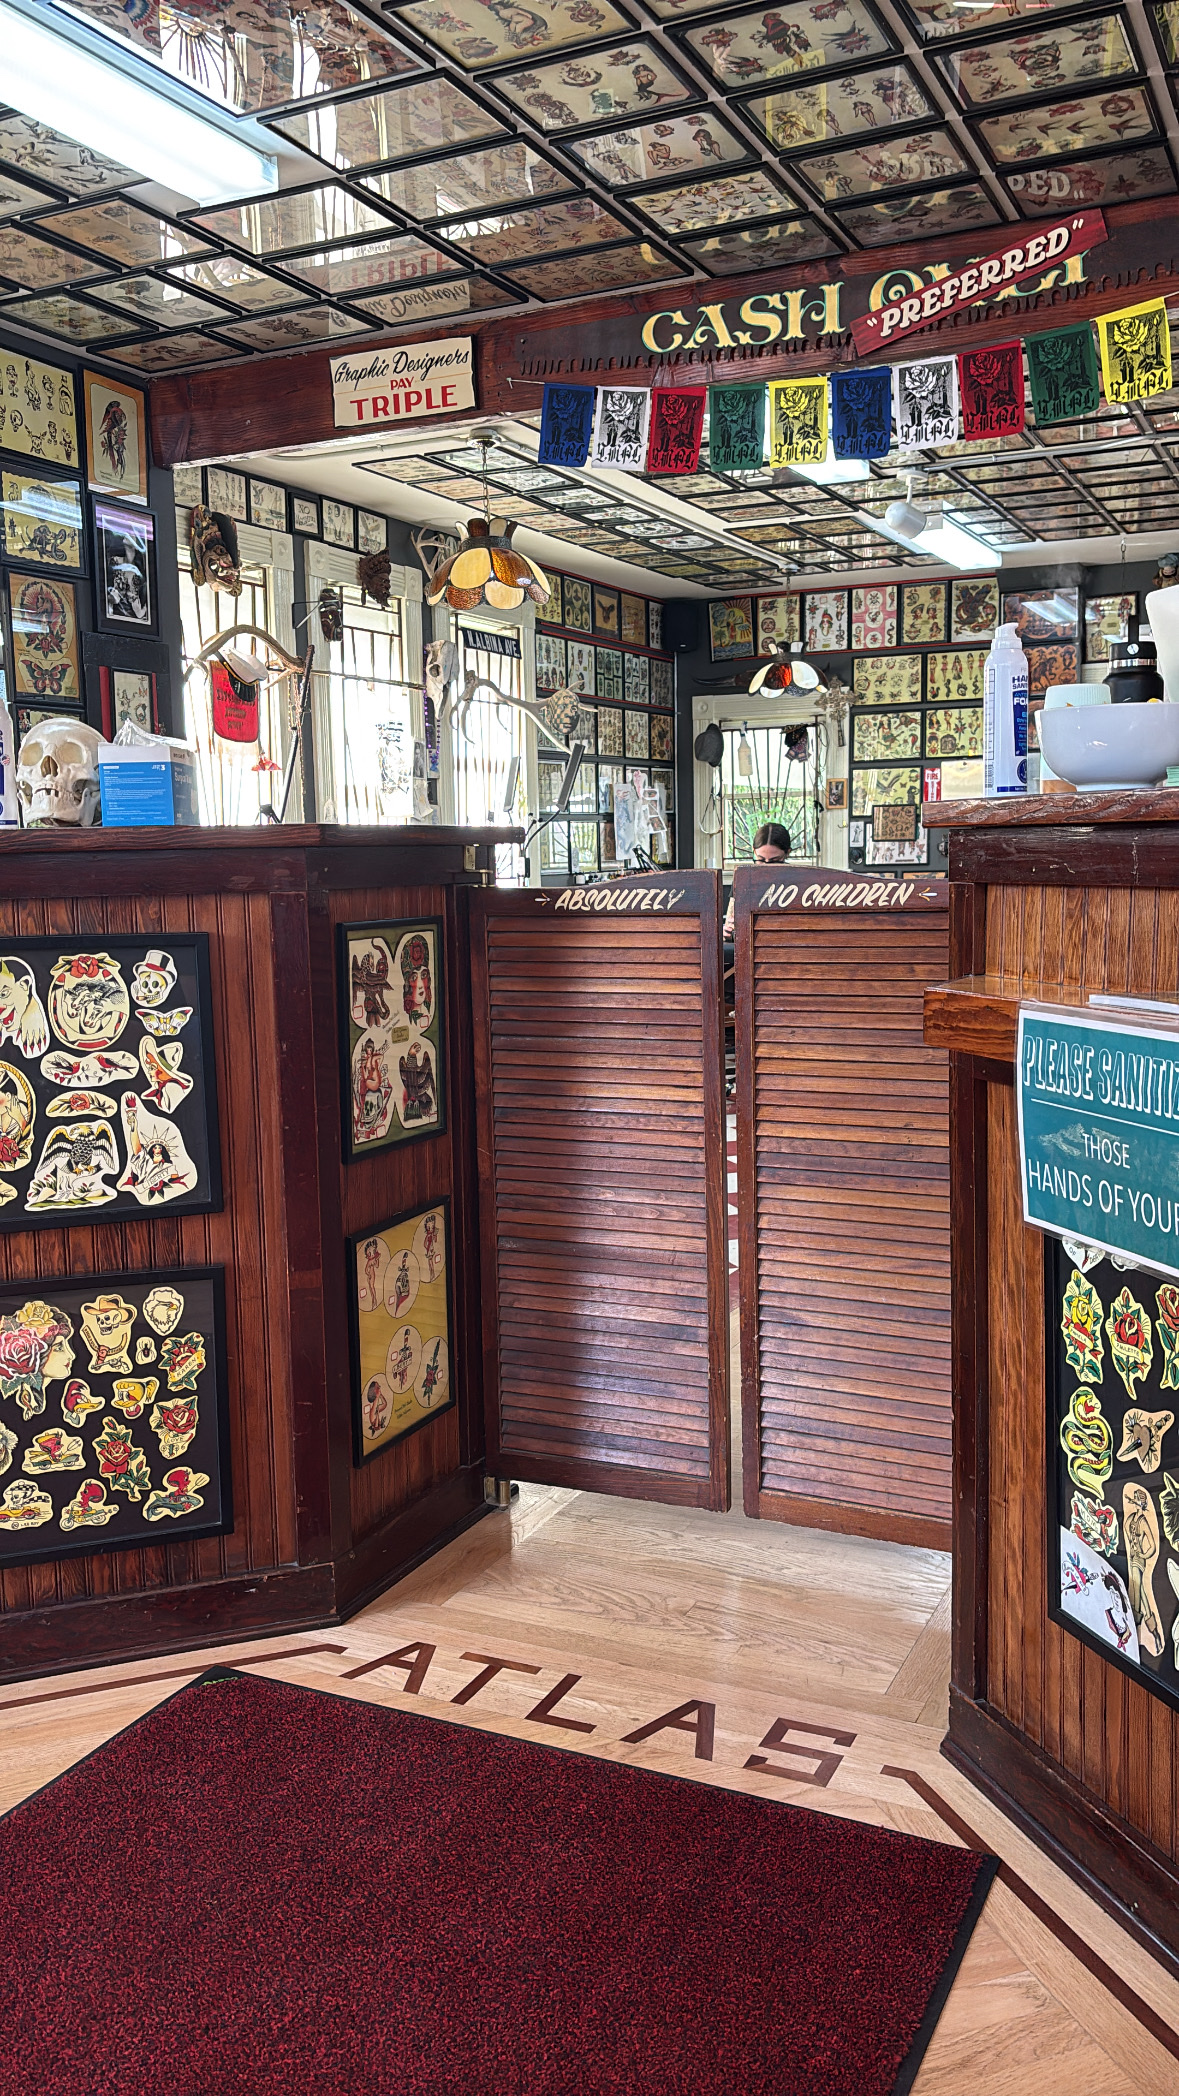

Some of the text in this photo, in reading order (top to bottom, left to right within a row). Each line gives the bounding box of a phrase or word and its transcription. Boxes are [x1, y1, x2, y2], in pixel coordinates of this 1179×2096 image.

[640, 280, 847, 354] CASH
[334, 348, 470, 391] Graphic Designers
[389, 376, 415, 391] PAY
[350, 384, 458, 421] TRIPLE
[554, 888, 685, 911] ABSOLUTELY
[759, 882, 916, 908] NO CHILDREN
[1023, 1034, 1094, 1102] PLEASE
[1082, 1132, 1131, 1169] THOSE
[1027, 1158, 1092, 1207] HANDS
[1098, 1179, 1124, 1217] OF
[176, 1357, 197, 1377] KAREN
[166, 1436, 184, 1444] LOVE
[339, 1641, 858, 1788] ATLAS
